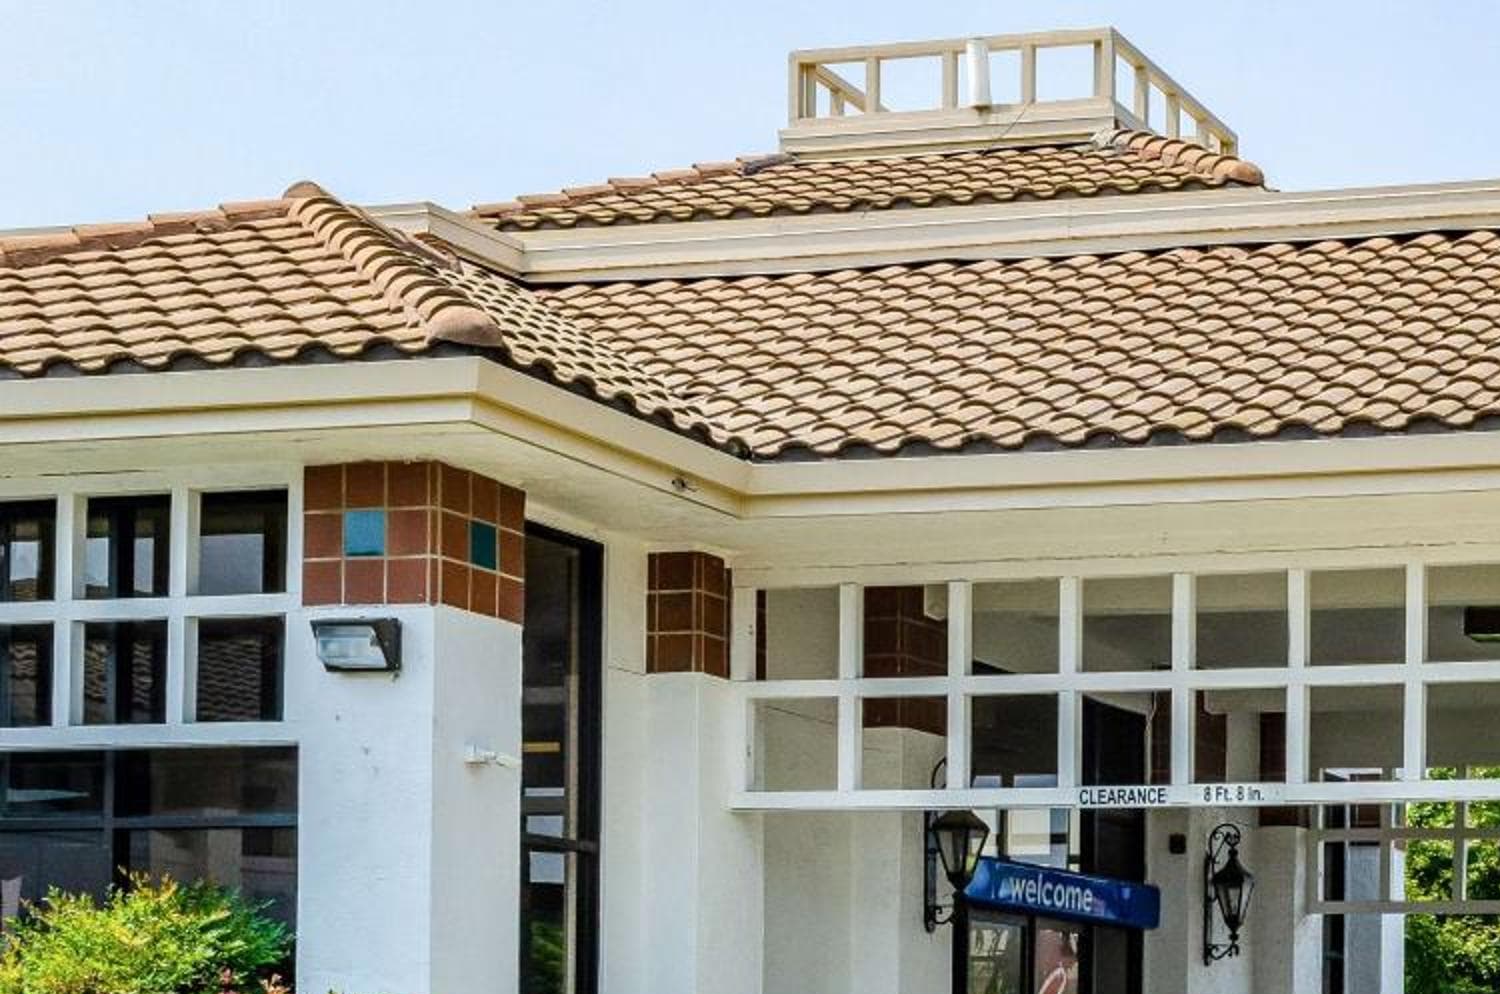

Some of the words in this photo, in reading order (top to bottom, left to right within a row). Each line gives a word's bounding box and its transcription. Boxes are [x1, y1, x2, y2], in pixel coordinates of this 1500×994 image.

[1079, 787, 1167, 805] CLEARANCE
[1203, 786, 1212, 801] 8
[1215, 786, 1232, 801] Ft.
[1237, 785, 1246, 801] 8
[1009, 872, 1094, 912] welcome
